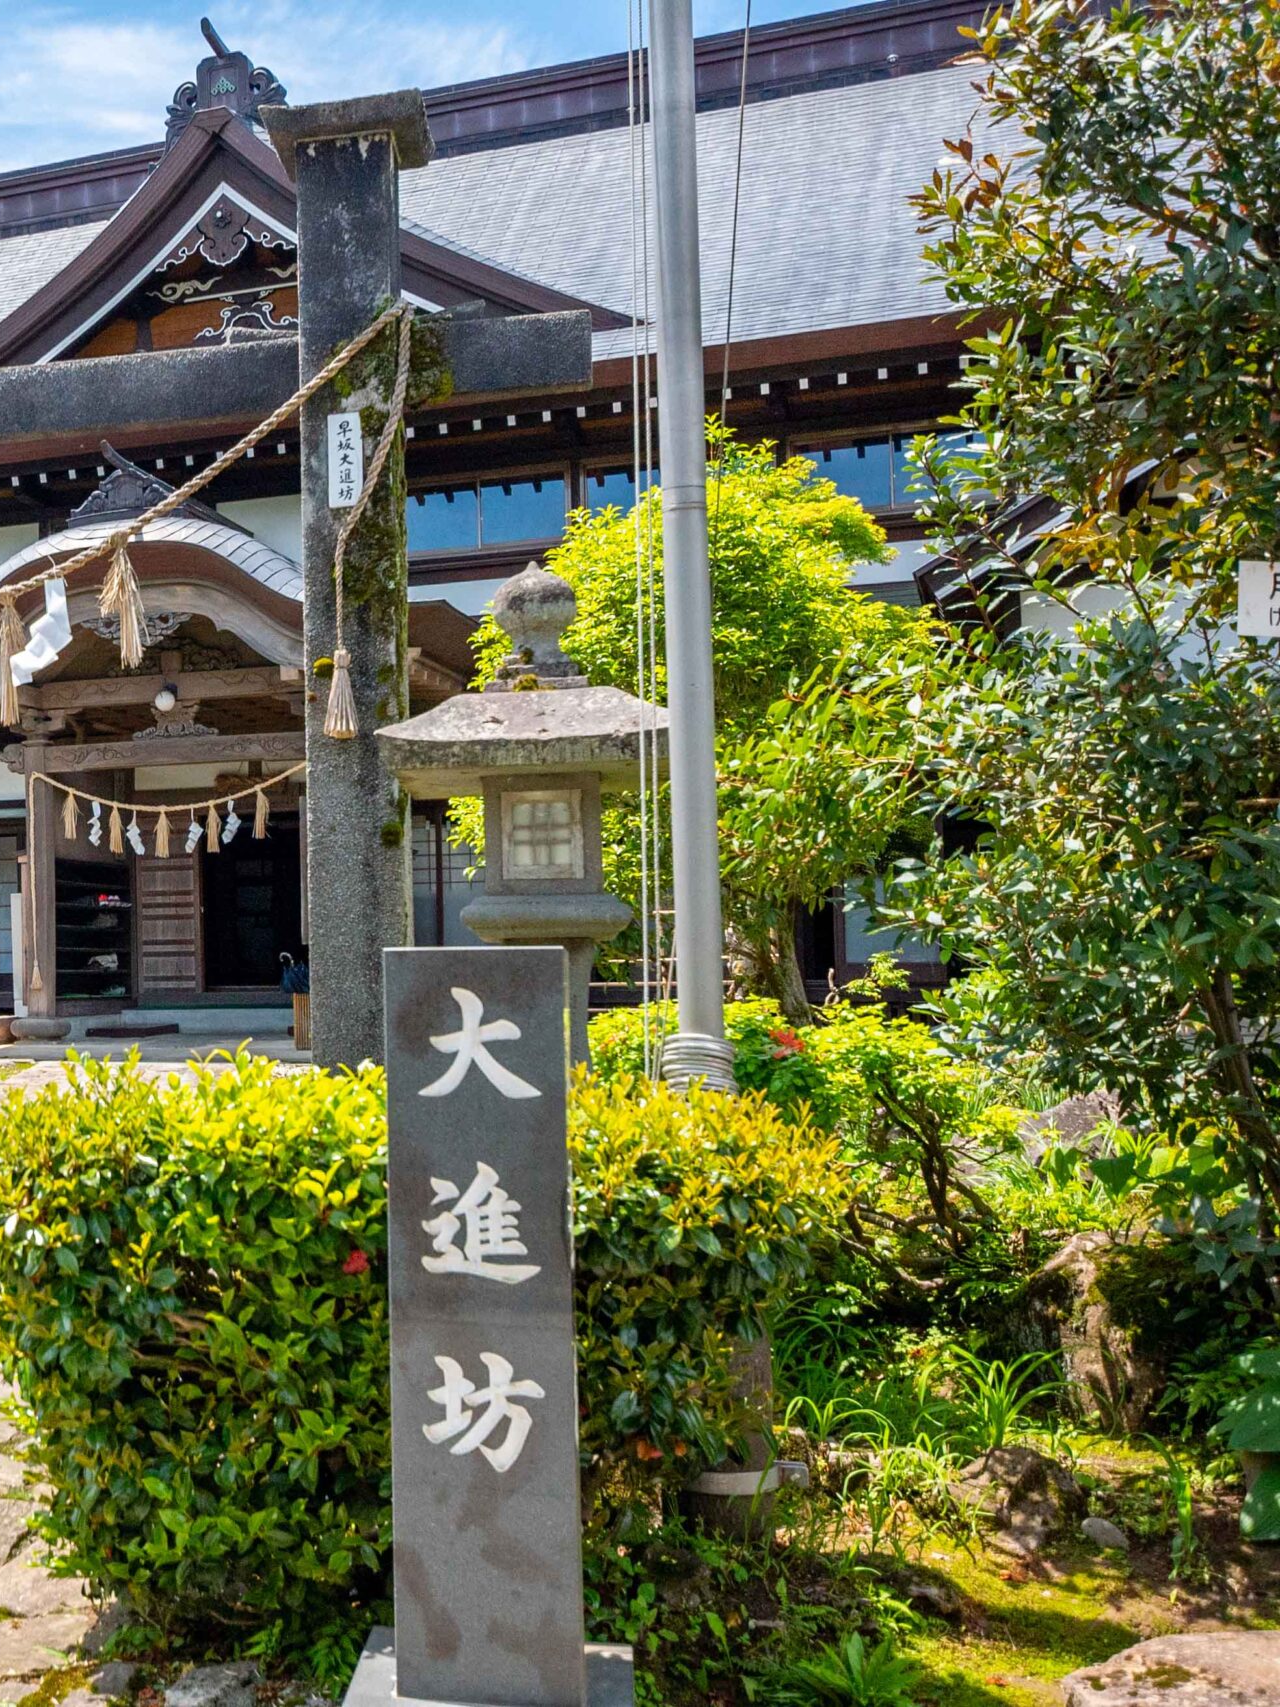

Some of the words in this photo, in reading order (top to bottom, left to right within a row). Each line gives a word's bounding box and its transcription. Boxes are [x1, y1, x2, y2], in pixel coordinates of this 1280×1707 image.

[337, 420, 355, 500] 早坂大進坊
[417, 986, 546, 1473] 大進坊
